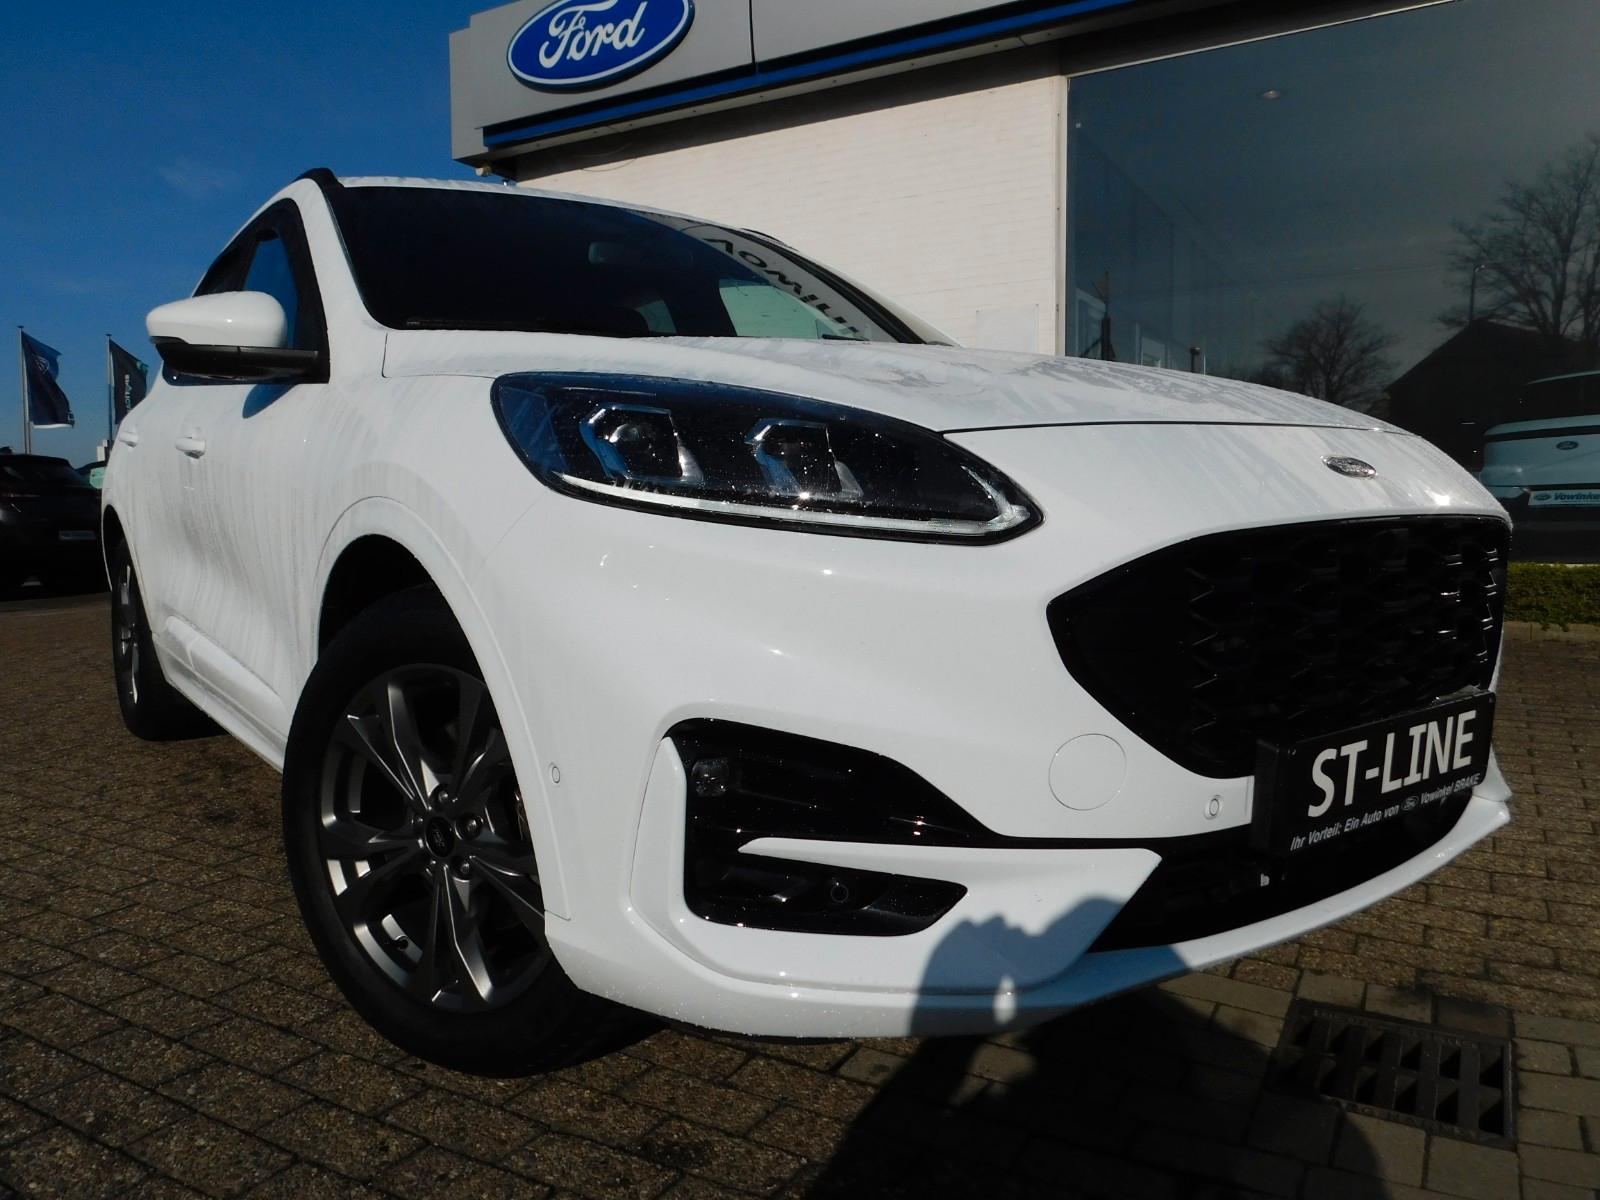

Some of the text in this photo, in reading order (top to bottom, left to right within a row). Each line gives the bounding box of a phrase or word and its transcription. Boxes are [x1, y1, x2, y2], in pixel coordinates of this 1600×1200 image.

[538, 0, 648, 68] Ford
[1307, 709, 1477, 818] ST-LINE
[1290, 836, 1306, 851] Ihr
[1308, 822, 1341, 846] Vorteil:
[1344, 816, 1360, 833] Ein
[1361, 811, 1383, 828] Auto
[1384, 804, 1400, 818] von
